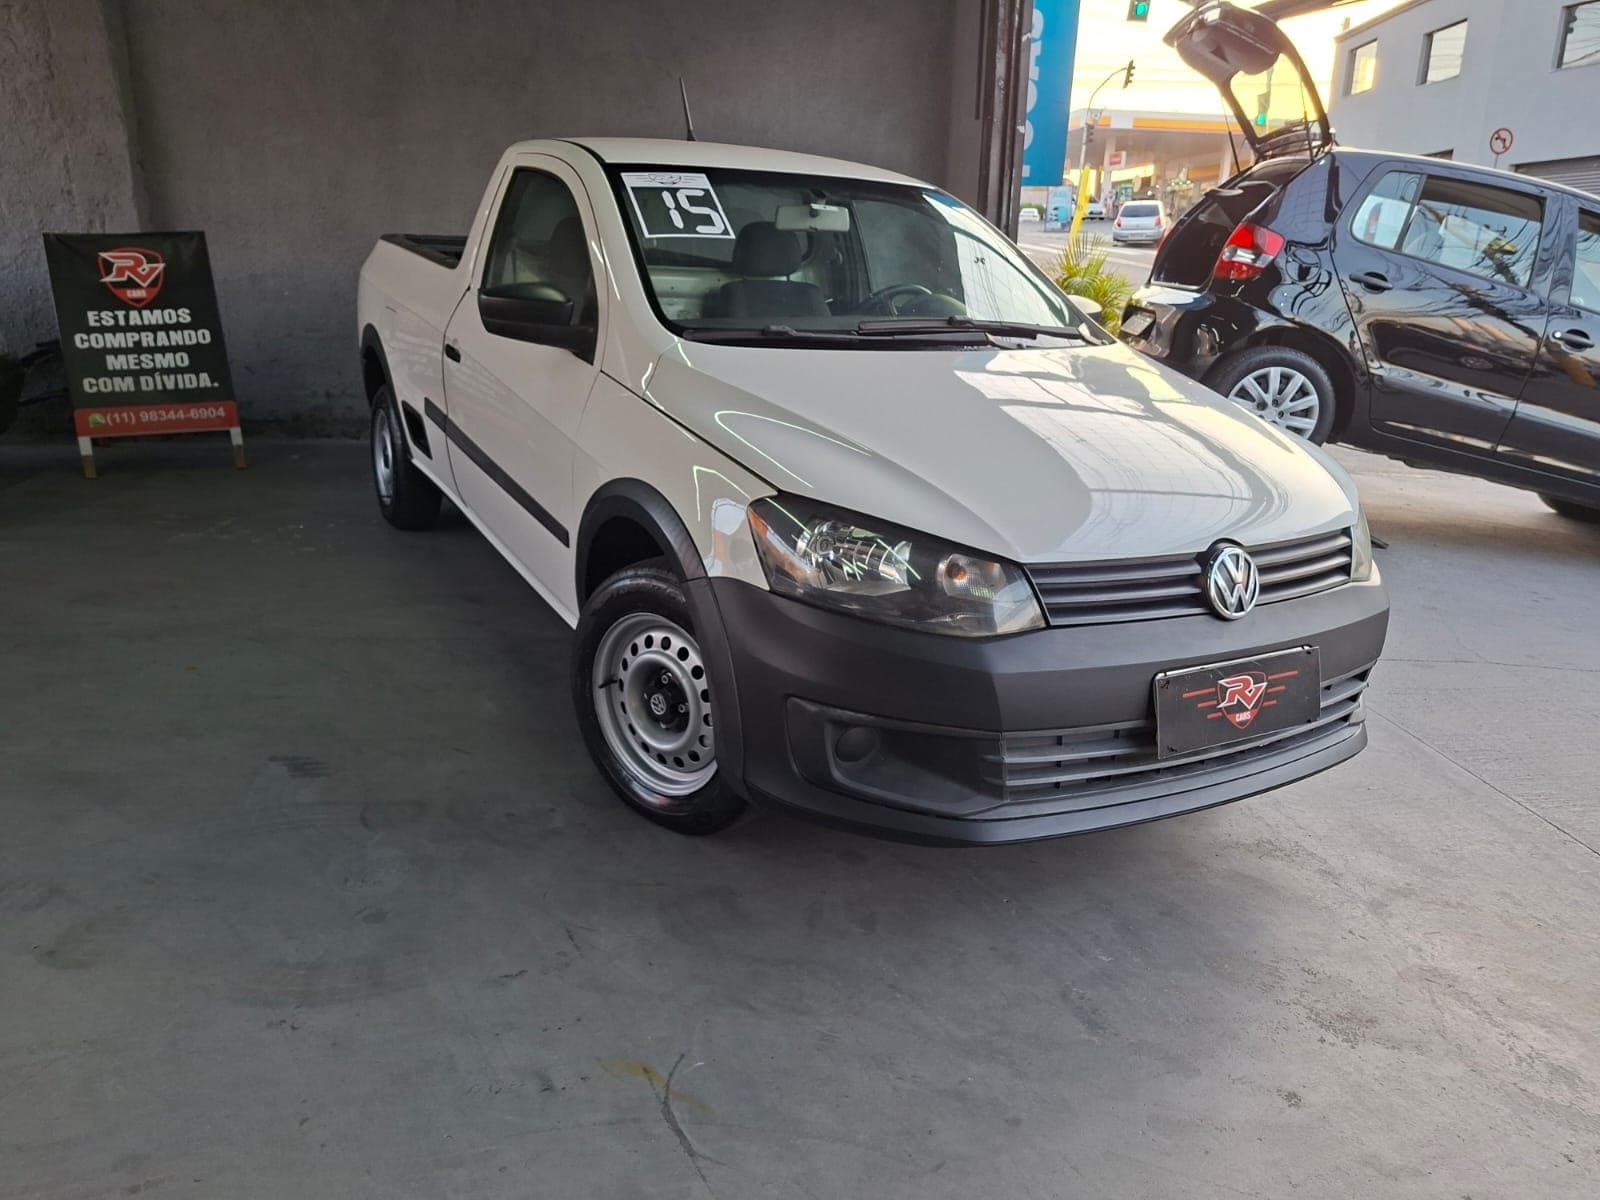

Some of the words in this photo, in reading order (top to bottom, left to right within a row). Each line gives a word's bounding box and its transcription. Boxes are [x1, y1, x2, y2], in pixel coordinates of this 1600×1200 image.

[662, 189, 725, 234] 15
[87, 308, 191, 327] ESTAMOS
[74, 329, 211, 349] COMPRANDO
[105, 352, 189, 371] MESMO
[82, 375, 135, 393] COM
[140, 372, 219, 391] DÍVIDA.
[106, 411, 135, 426] (11)
